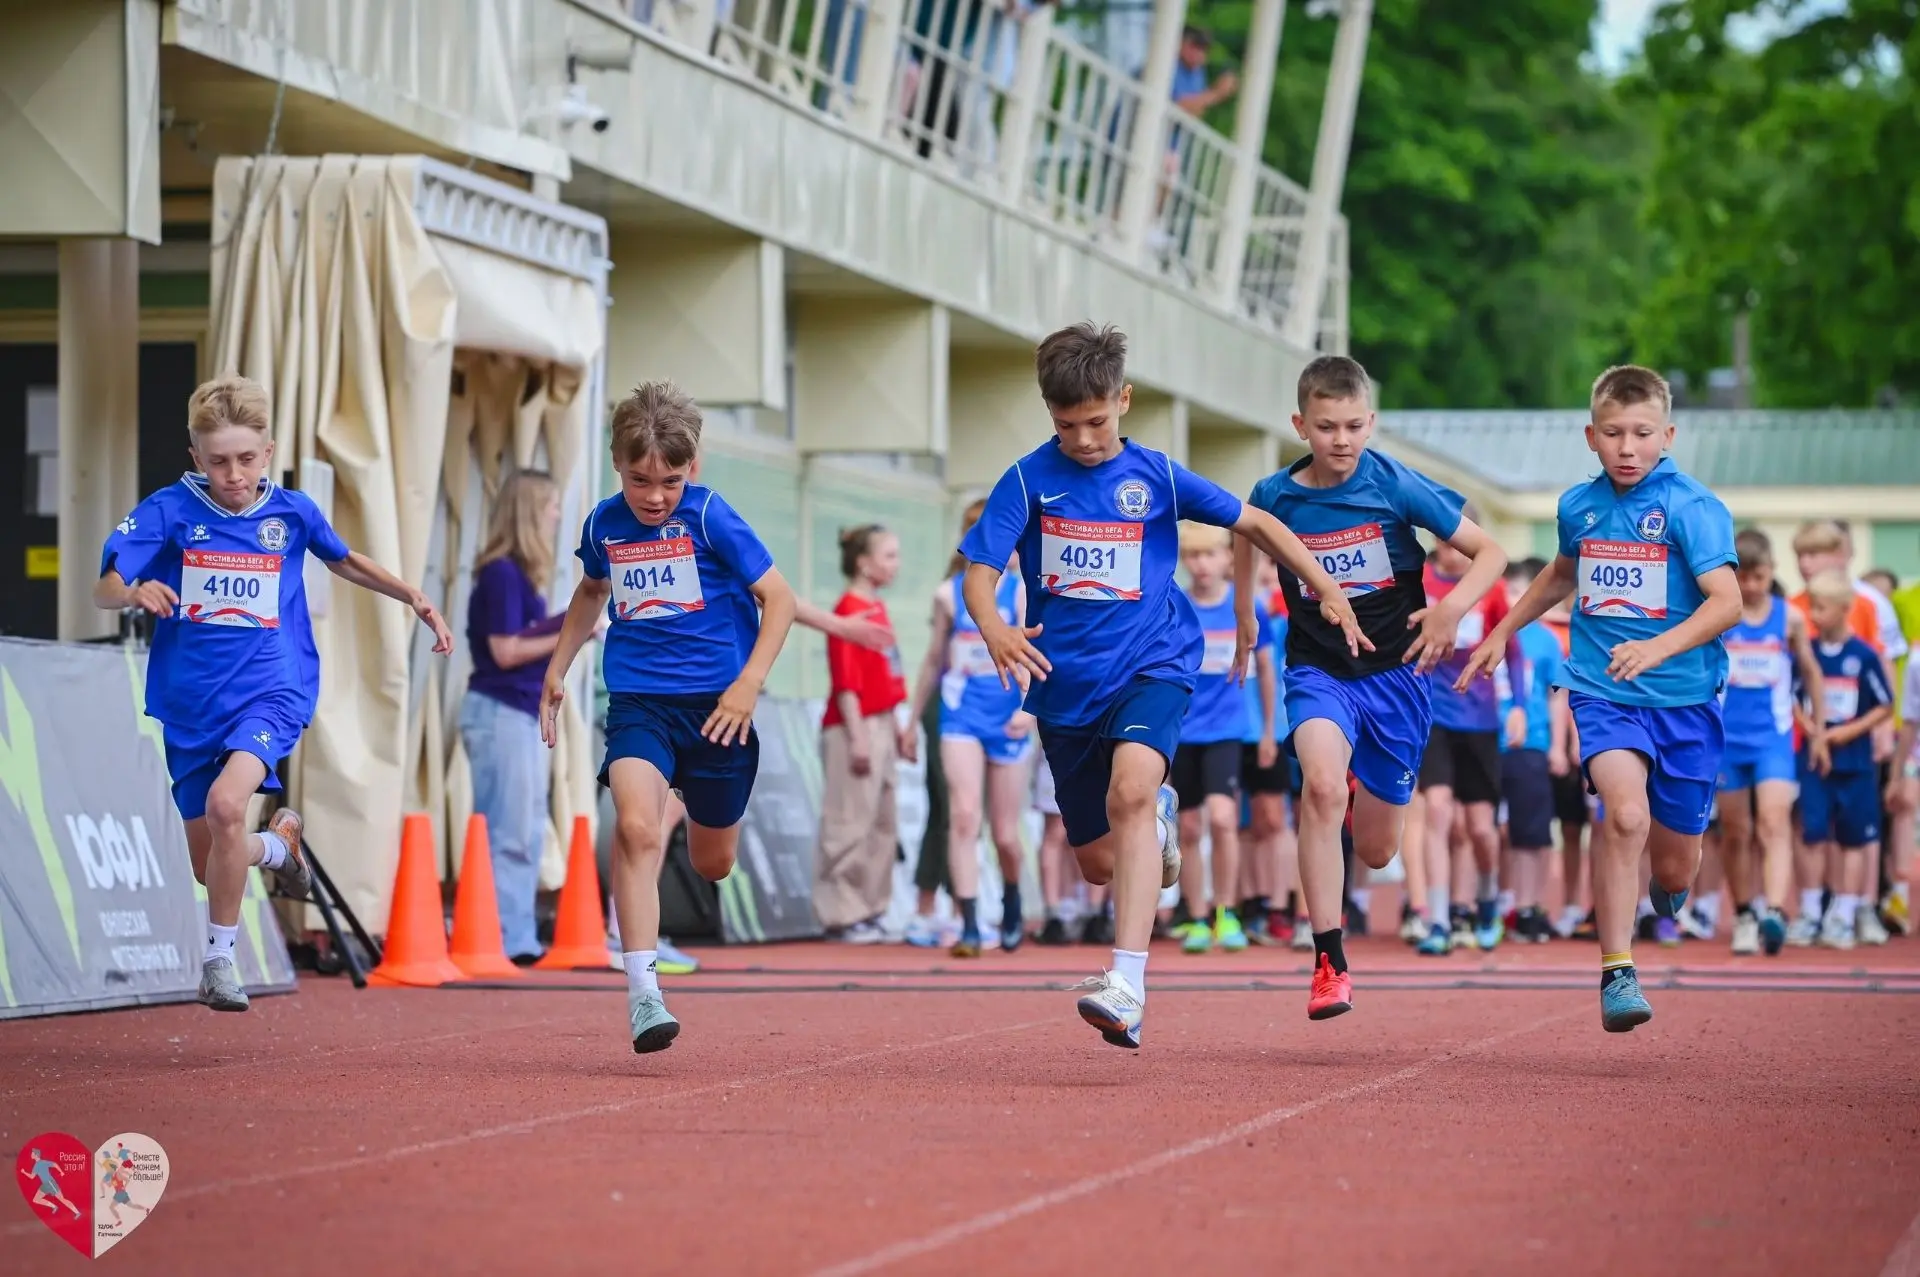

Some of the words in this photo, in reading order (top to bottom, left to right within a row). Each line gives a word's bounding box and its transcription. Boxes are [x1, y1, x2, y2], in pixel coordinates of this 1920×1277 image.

[1061, 523, 1103, 533] ФЕСТИВАЛЬ
[1302, 535, 1343, 545] ФЕСТИВАЛЬ
[1344, 531, 1361, 539] БЕГА
[615, 546, 655, 556] ФЕСТИВАЛЬ
[655, 544, 673, 552] БЕГА
[1590, 544, 1627, 552] ФЕСТИВАЛЬ
[203, 554, 248, 564] ФЕСТИВАЛЬ
[247, 556, 264, 565] БЕГА
[1060, 545, 1116, 570] 4031
[1315, 549, 1366, 575] 034
[623, 565, 676, 590] 4014
[1066, 568, 1109, 578] ВЛАДИСЛАВ
[1332, 573, 1352, 581] РТЕМ
[1590, 565, 1643, 588] 4093
[203, 575, 260, 599] 4100
[65, 812, 166, 892] ЮФЛ
